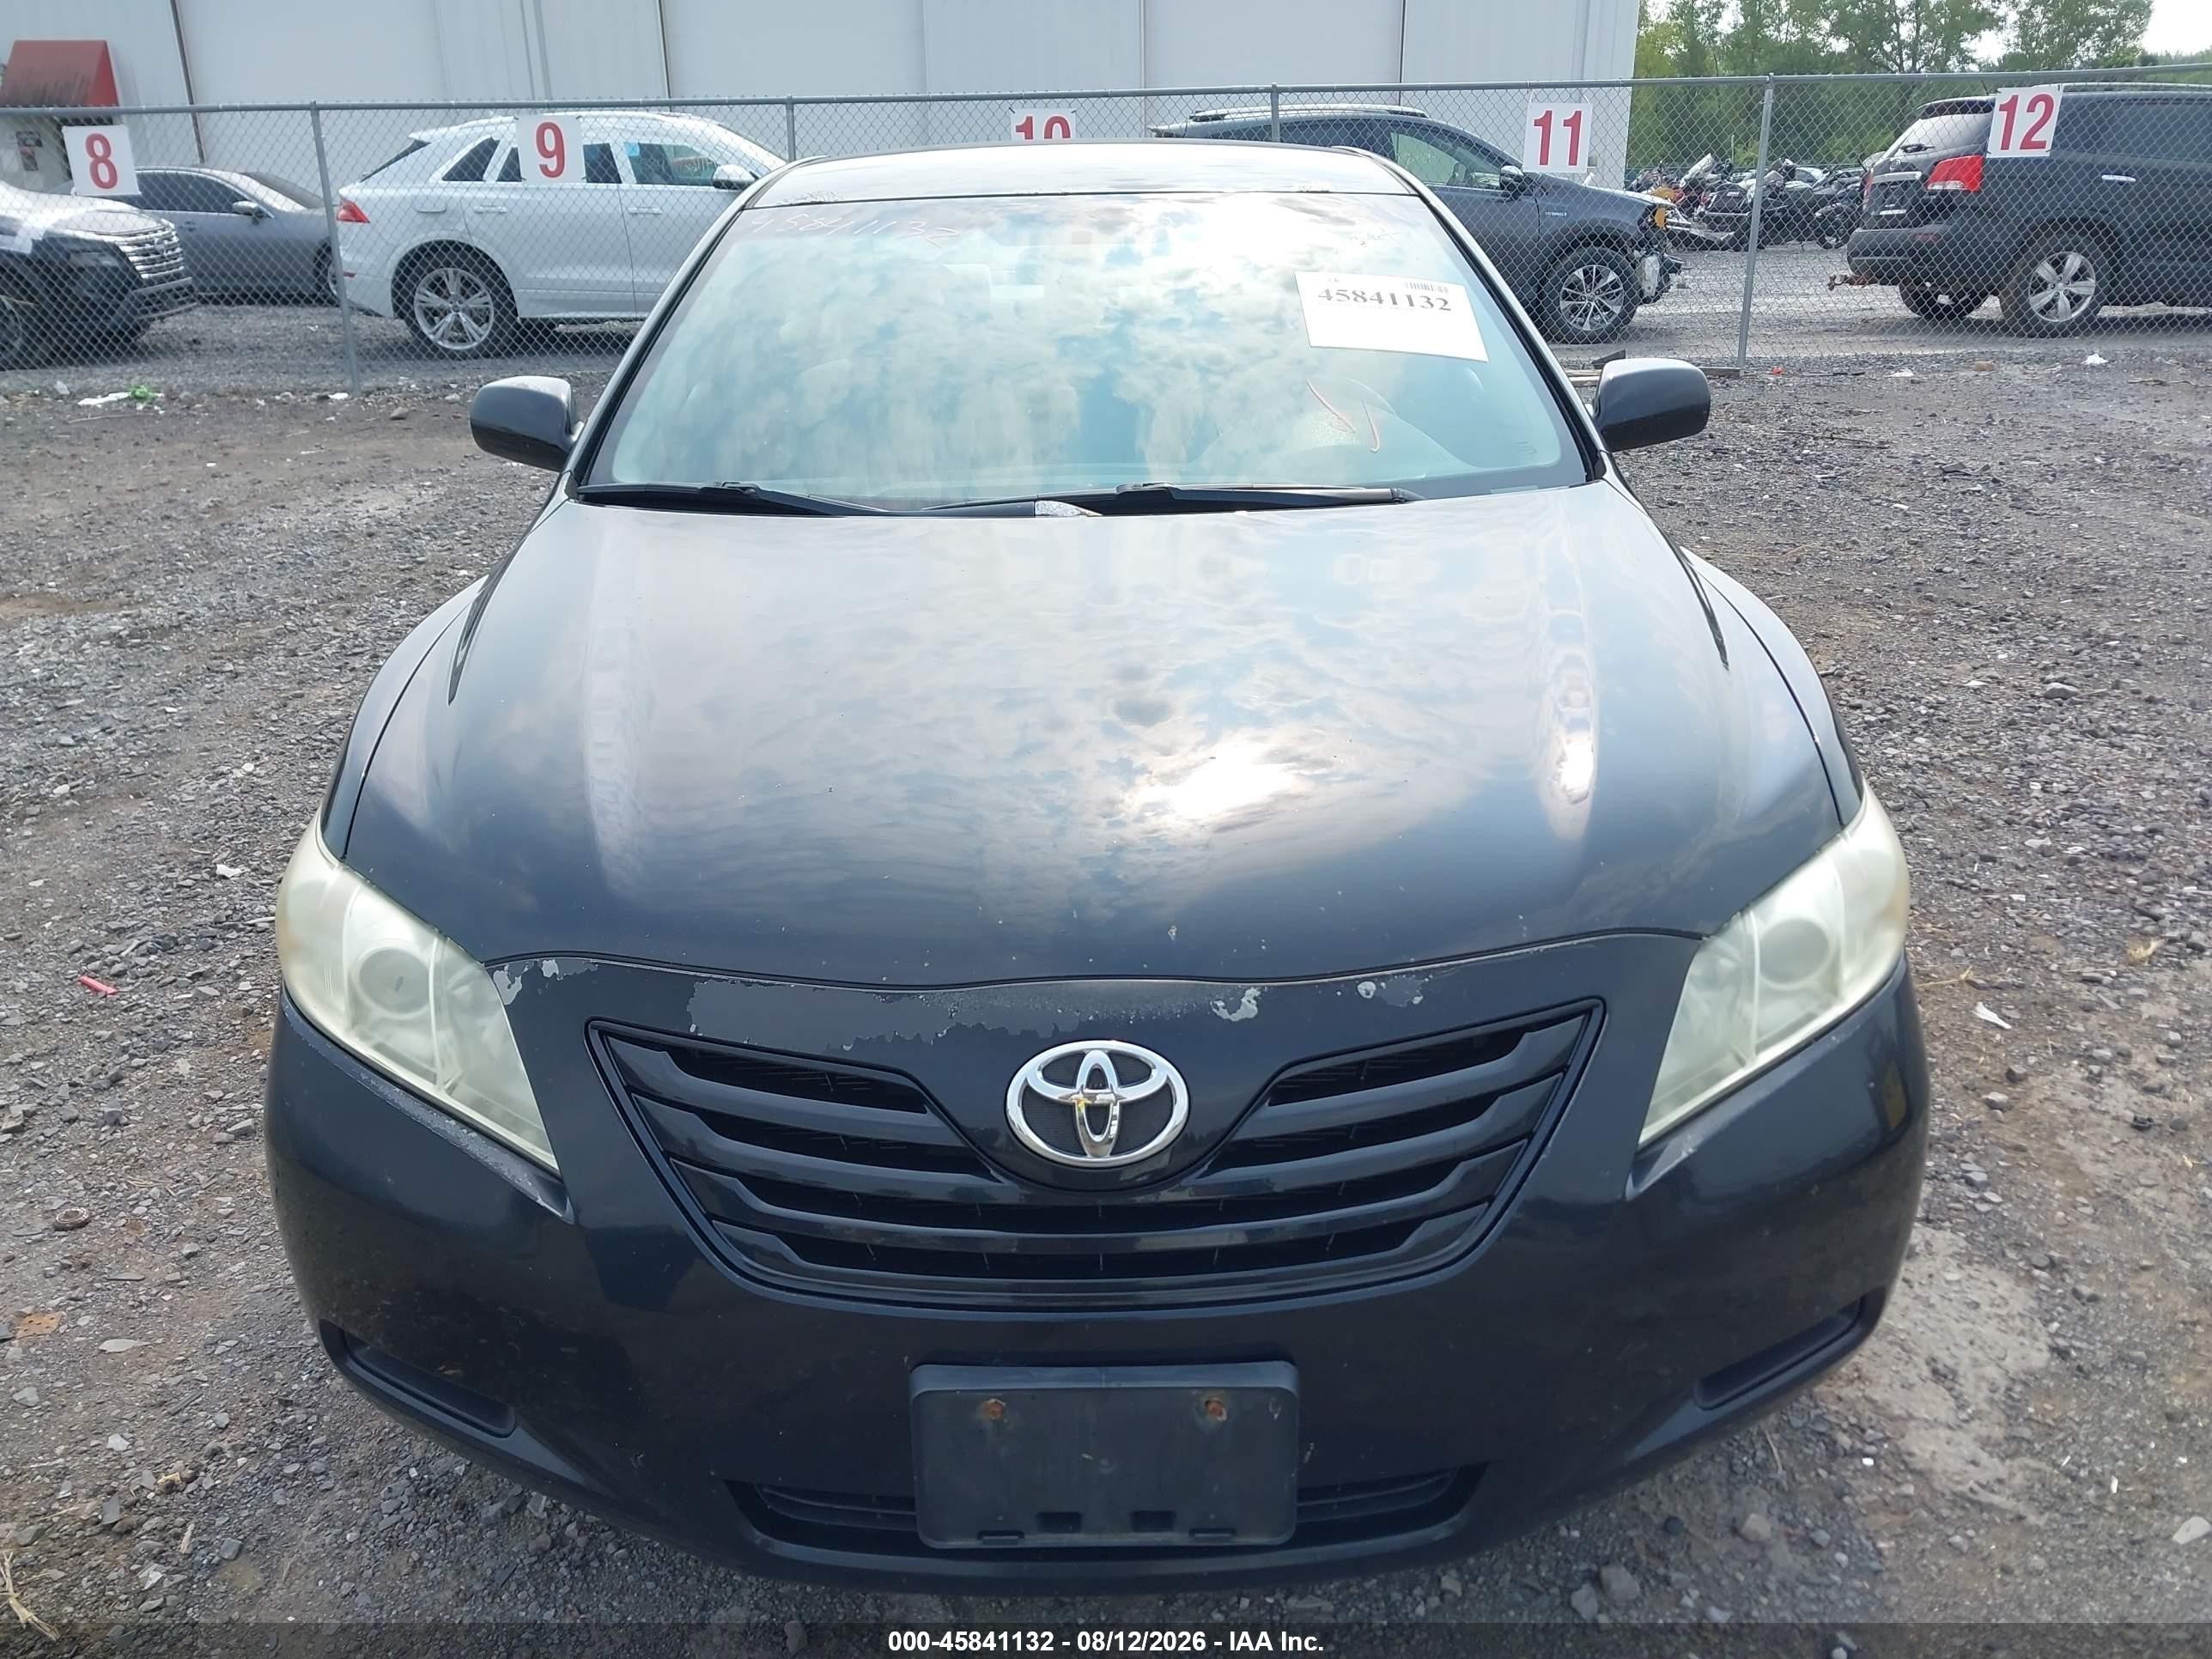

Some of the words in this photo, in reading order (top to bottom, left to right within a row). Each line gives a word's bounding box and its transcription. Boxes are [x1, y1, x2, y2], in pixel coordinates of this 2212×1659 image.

[536, 122, 565, 178] 9
[1534, 110, 1583, 166] 11
[2000, 94, 2055, 151] 12
[85, 132, 118, 189] 8
[1317, 288, 1452, 312] 45841132
